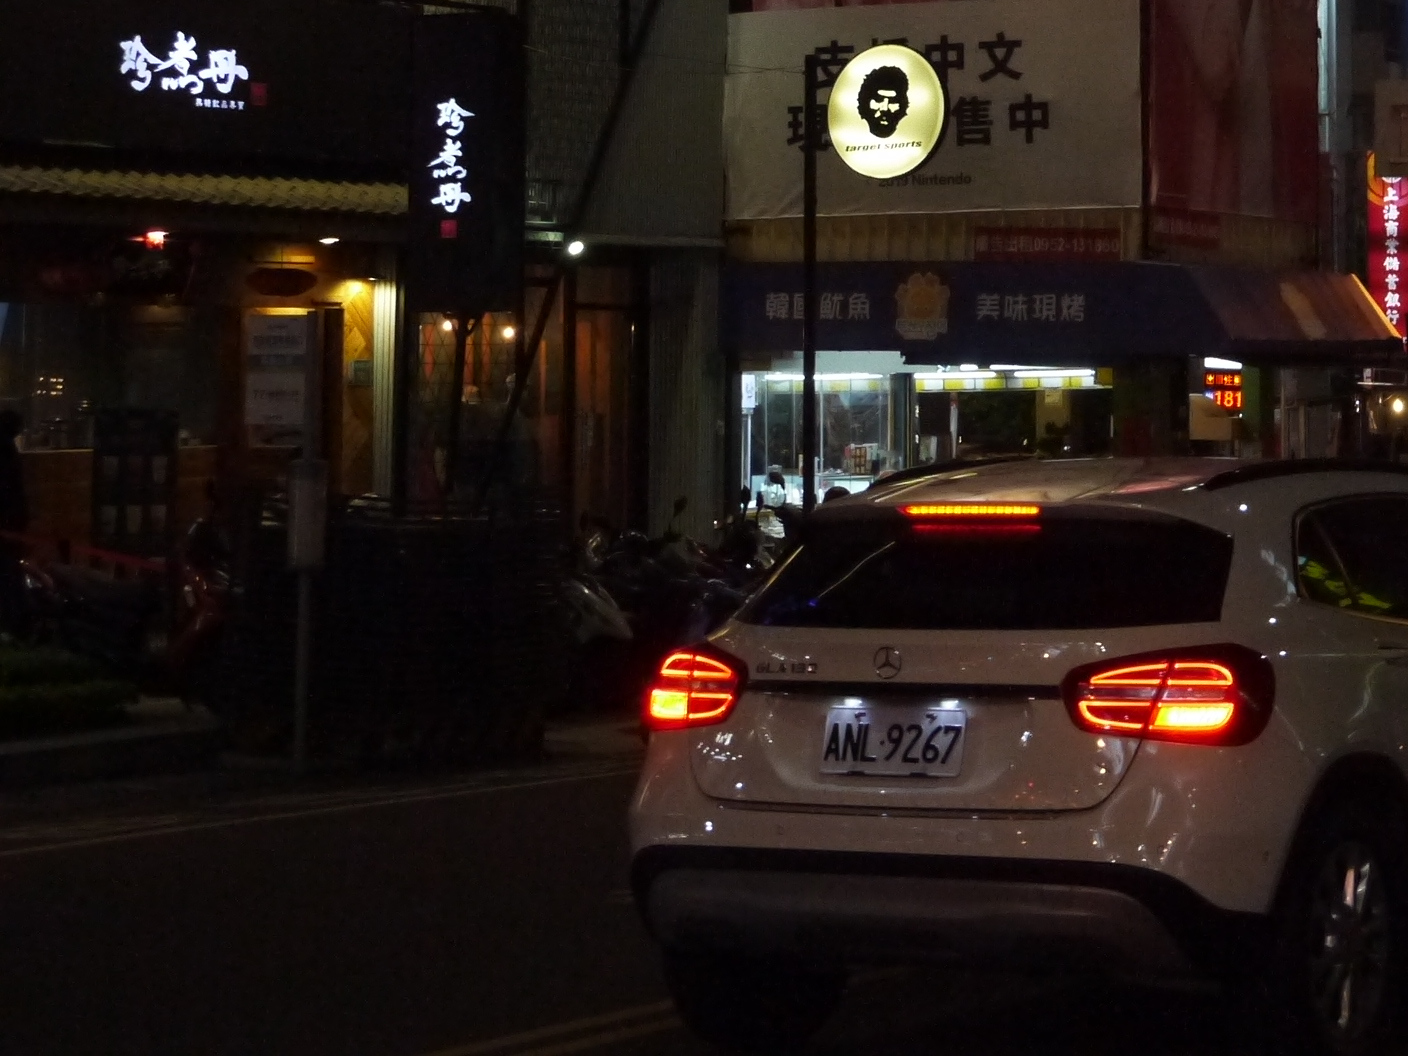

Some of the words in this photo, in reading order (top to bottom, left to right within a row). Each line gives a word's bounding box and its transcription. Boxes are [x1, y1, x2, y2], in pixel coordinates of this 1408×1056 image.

[814, 32, 1022, 89] 支中文
[786, 93, 1050, 152] 現售中
[845, 144, 881, 153] target
[884, 140, 923, 150] sports
[911, 172, 972, 187] Nintendo
[976, 293, 1087, 322] 美味現烤
[1214, 390, 1242, 408] 181
